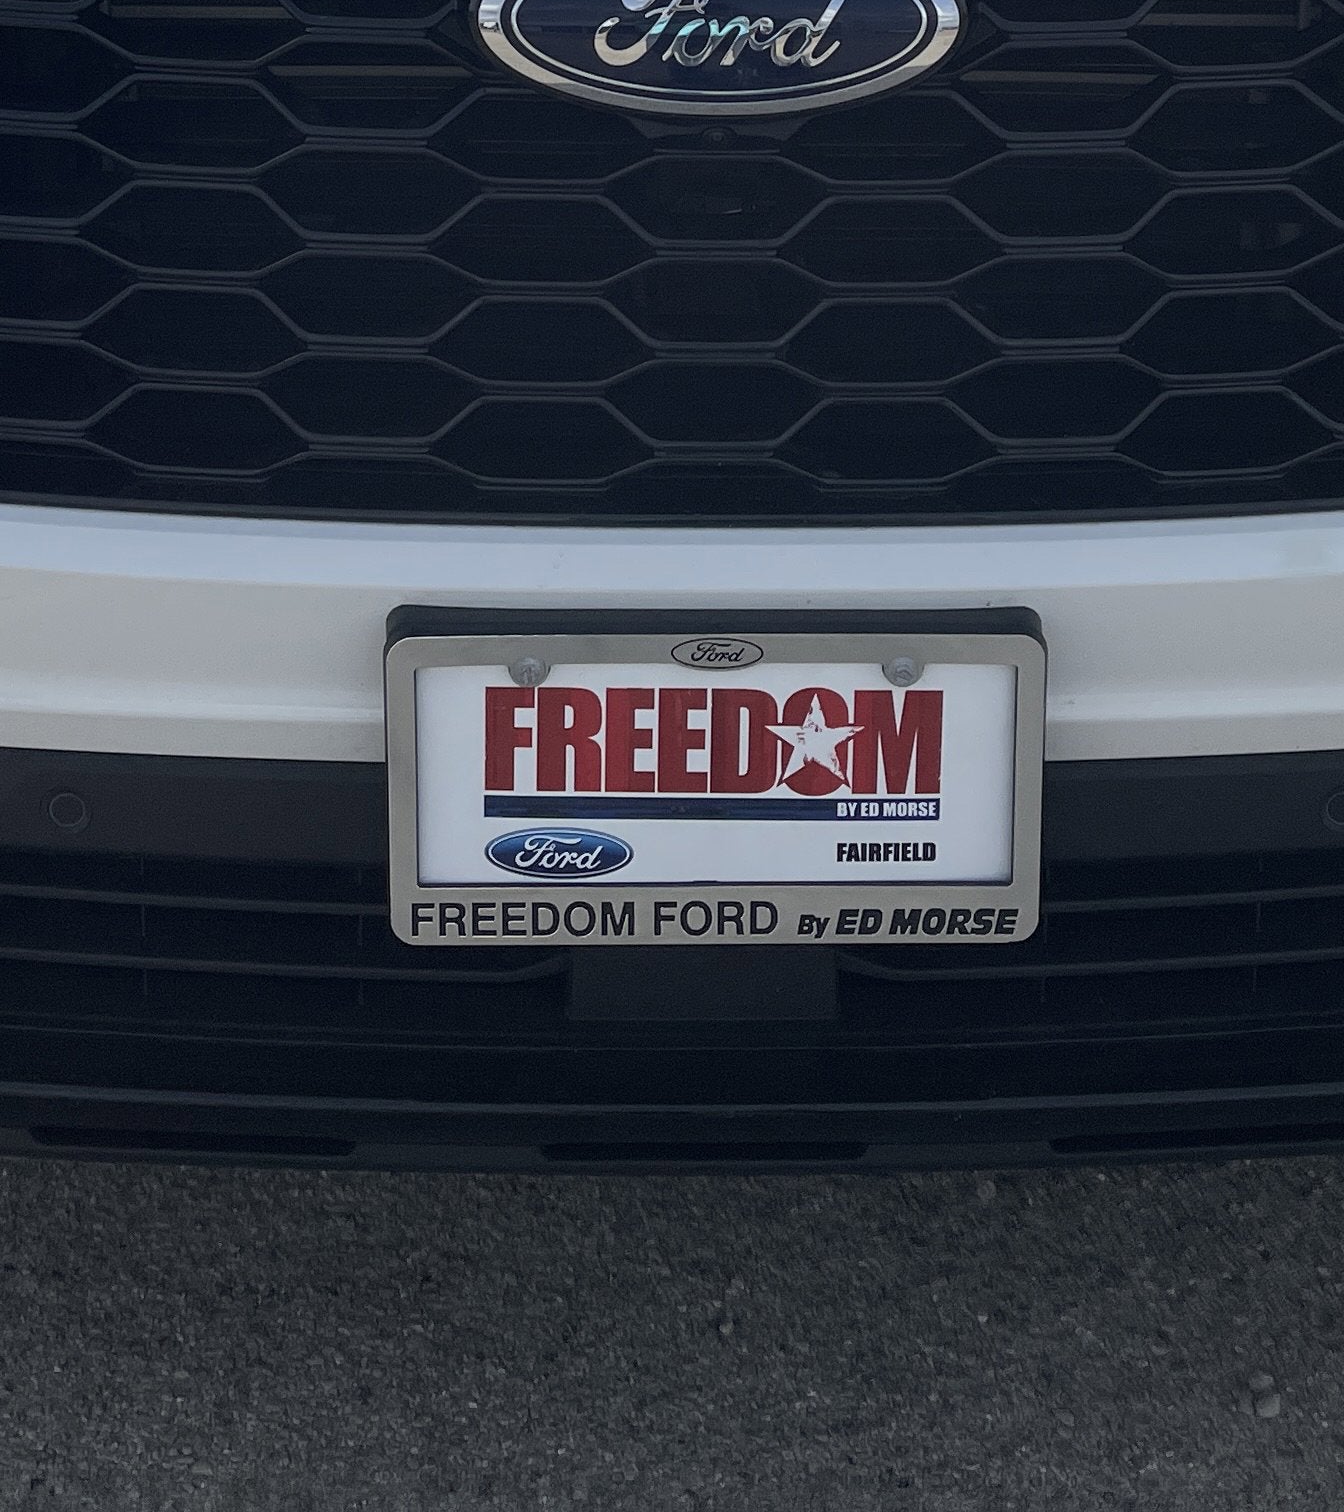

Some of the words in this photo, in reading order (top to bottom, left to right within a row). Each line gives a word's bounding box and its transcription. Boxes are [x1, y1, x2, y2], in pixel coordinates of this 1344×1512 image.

[690, 641, 745, 662] Ford
[484, 687, 944, 797] FREEDOM
[836, 801, 858, 818] BY
[860, 801, 880, 818] ED
[882, 801, 937, 818] MORSE
[514, 833, 602, 869] Ford
[836, 842, 937, 862] FAIRFIELD
[411, 901, 635, 937] FREEDOM
[653, 900, 778, 937] FORD
[797, 914, 831, 939] By
[835, 908, 884, 936] ED
[888, 907, 1020, 936] MORSE
